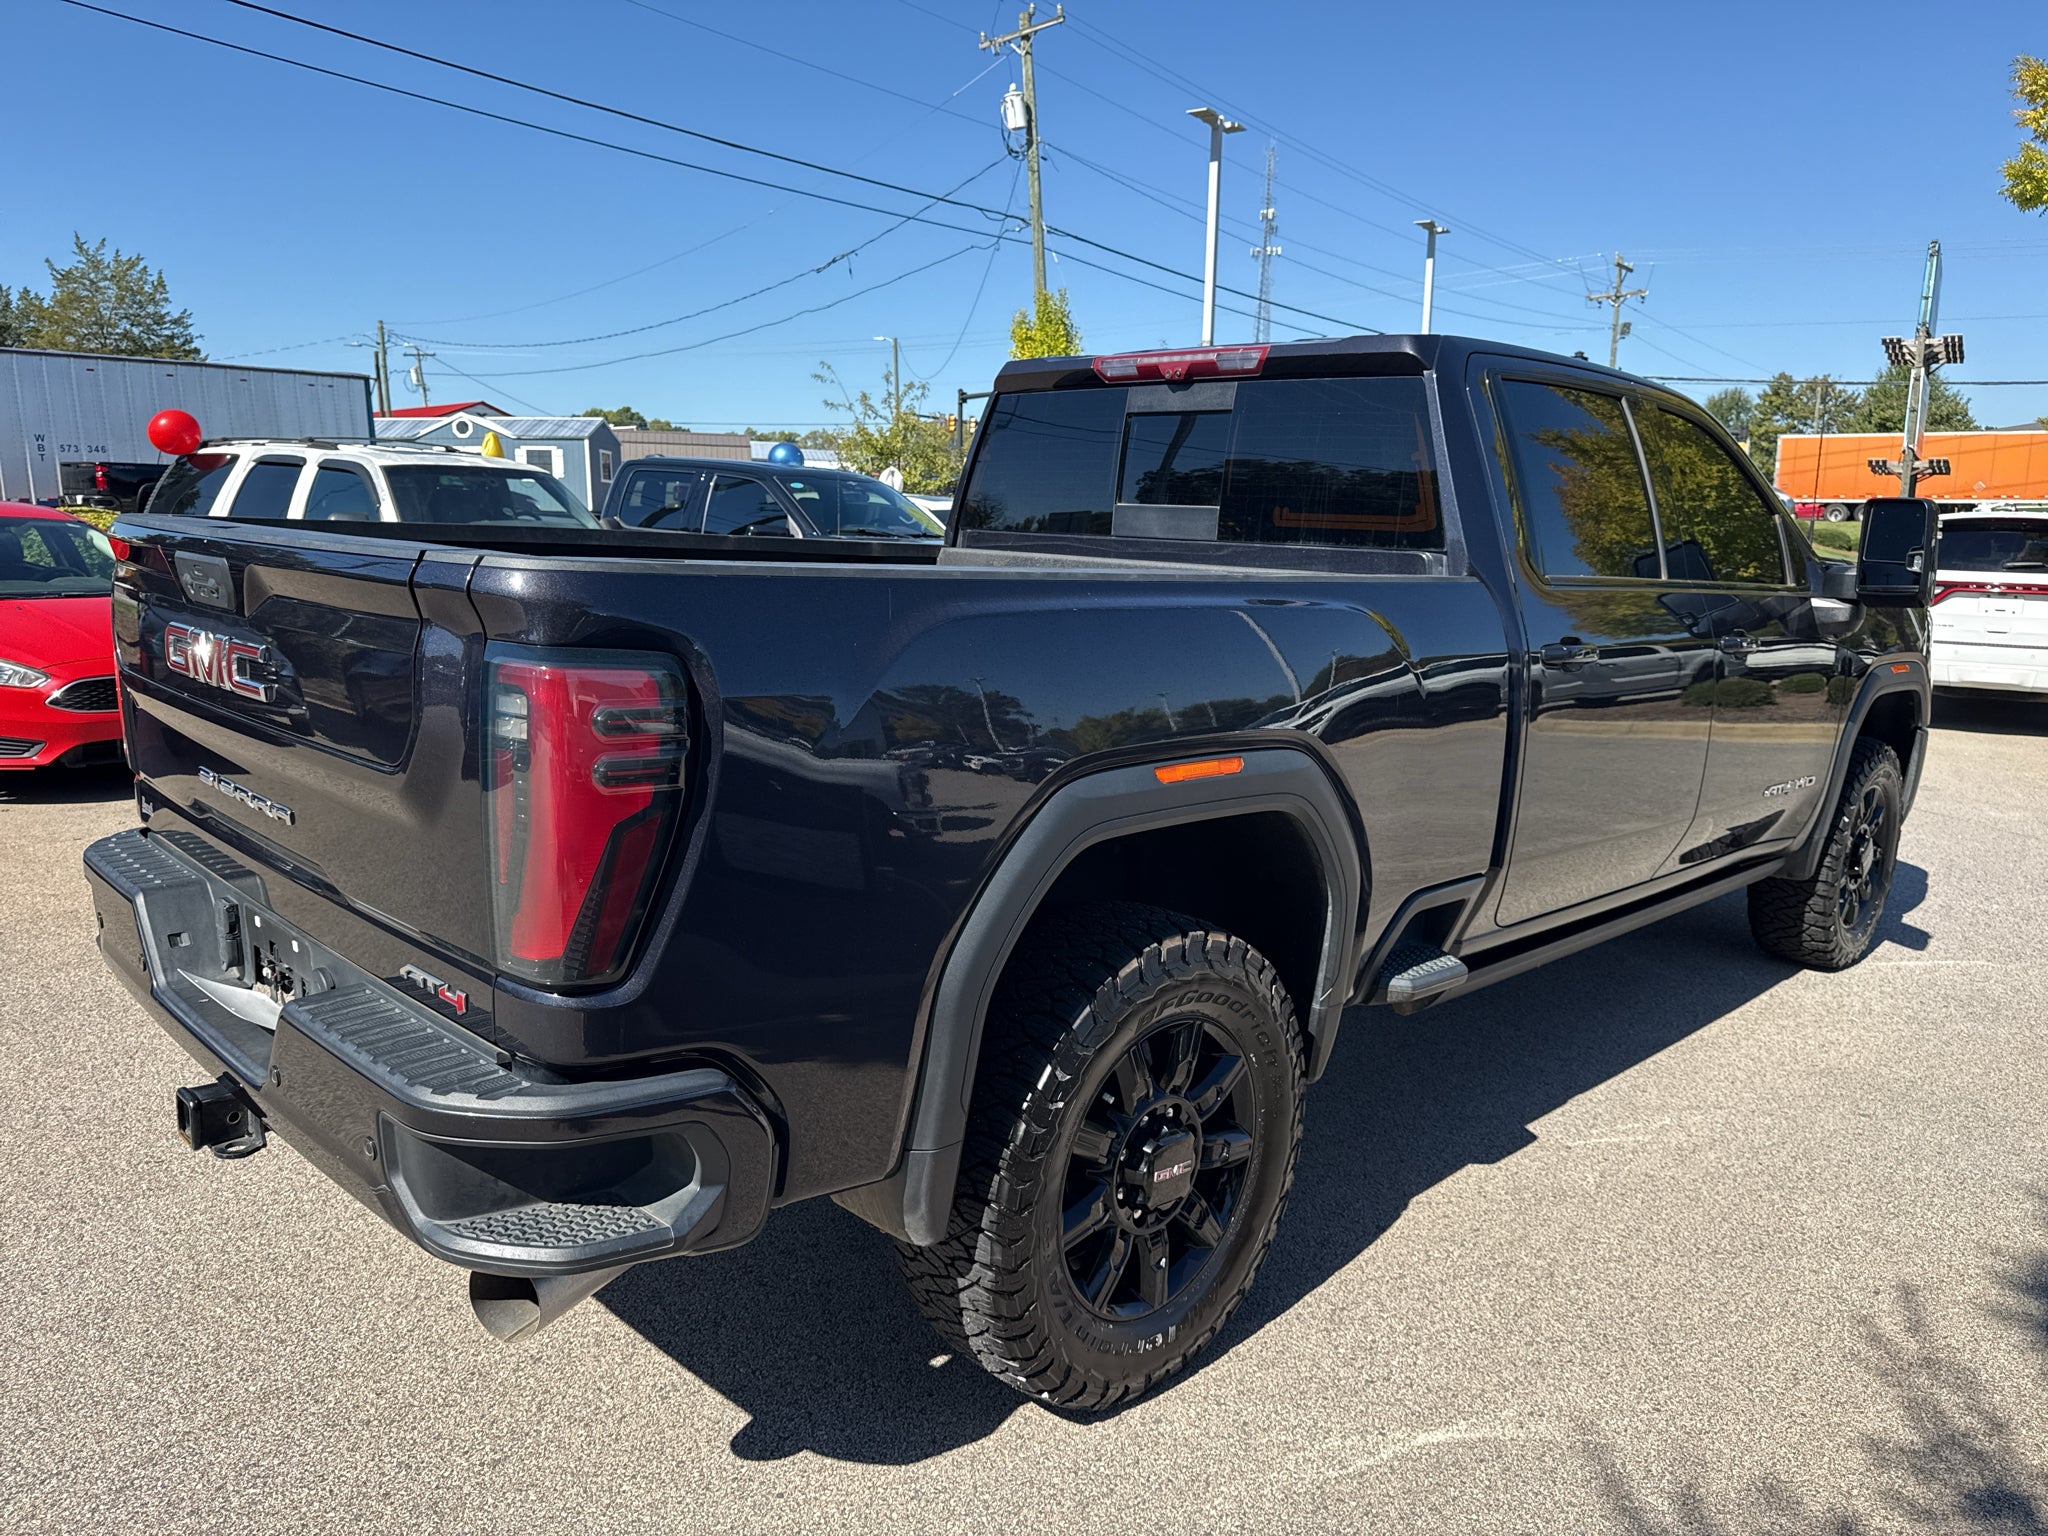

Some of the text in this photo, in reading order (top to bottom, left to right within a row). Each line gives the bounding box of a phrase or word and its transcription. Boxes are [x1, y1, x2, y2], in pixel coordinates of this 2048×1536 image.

[60, 444, 108, 454] 573 346
[165, 621, 279, 703] GMC
[198, 765, 297, 827] SIERRA
[399, 963, 469, 1016] AT4
[1153, 1159, 1192, 1183] GMC
